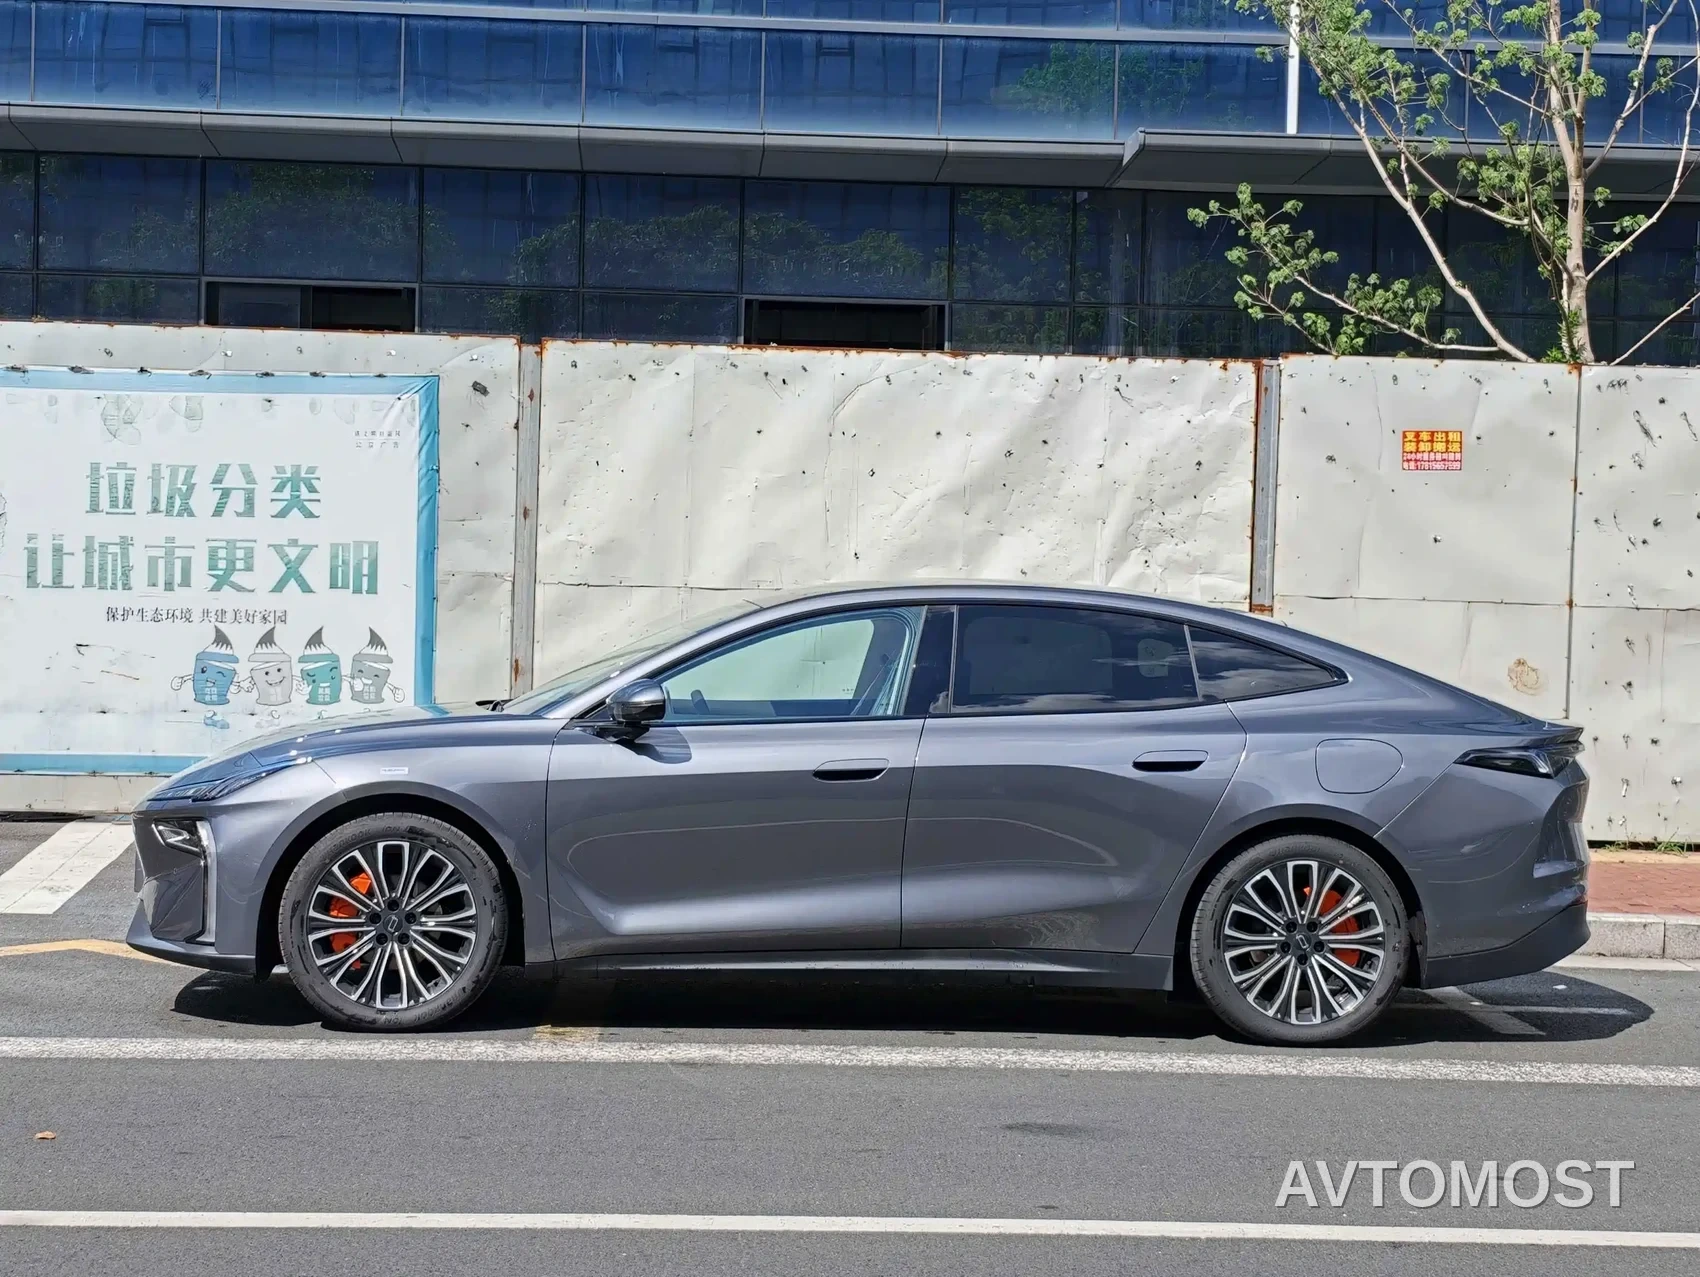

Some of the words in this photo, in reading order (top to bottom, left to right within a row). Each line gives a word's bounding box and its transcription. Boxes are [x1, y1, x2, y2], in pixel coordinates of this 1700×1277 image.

[1403, 431, 1461, 442] 叉车出租
[85, 462, 321, 518] 垃圾分类
[23, 533, 380, 595] 让城市更文明
[106, 606, 194, 624] 保护生态环境
[198, 608, 288, 626] 共建美好家园
